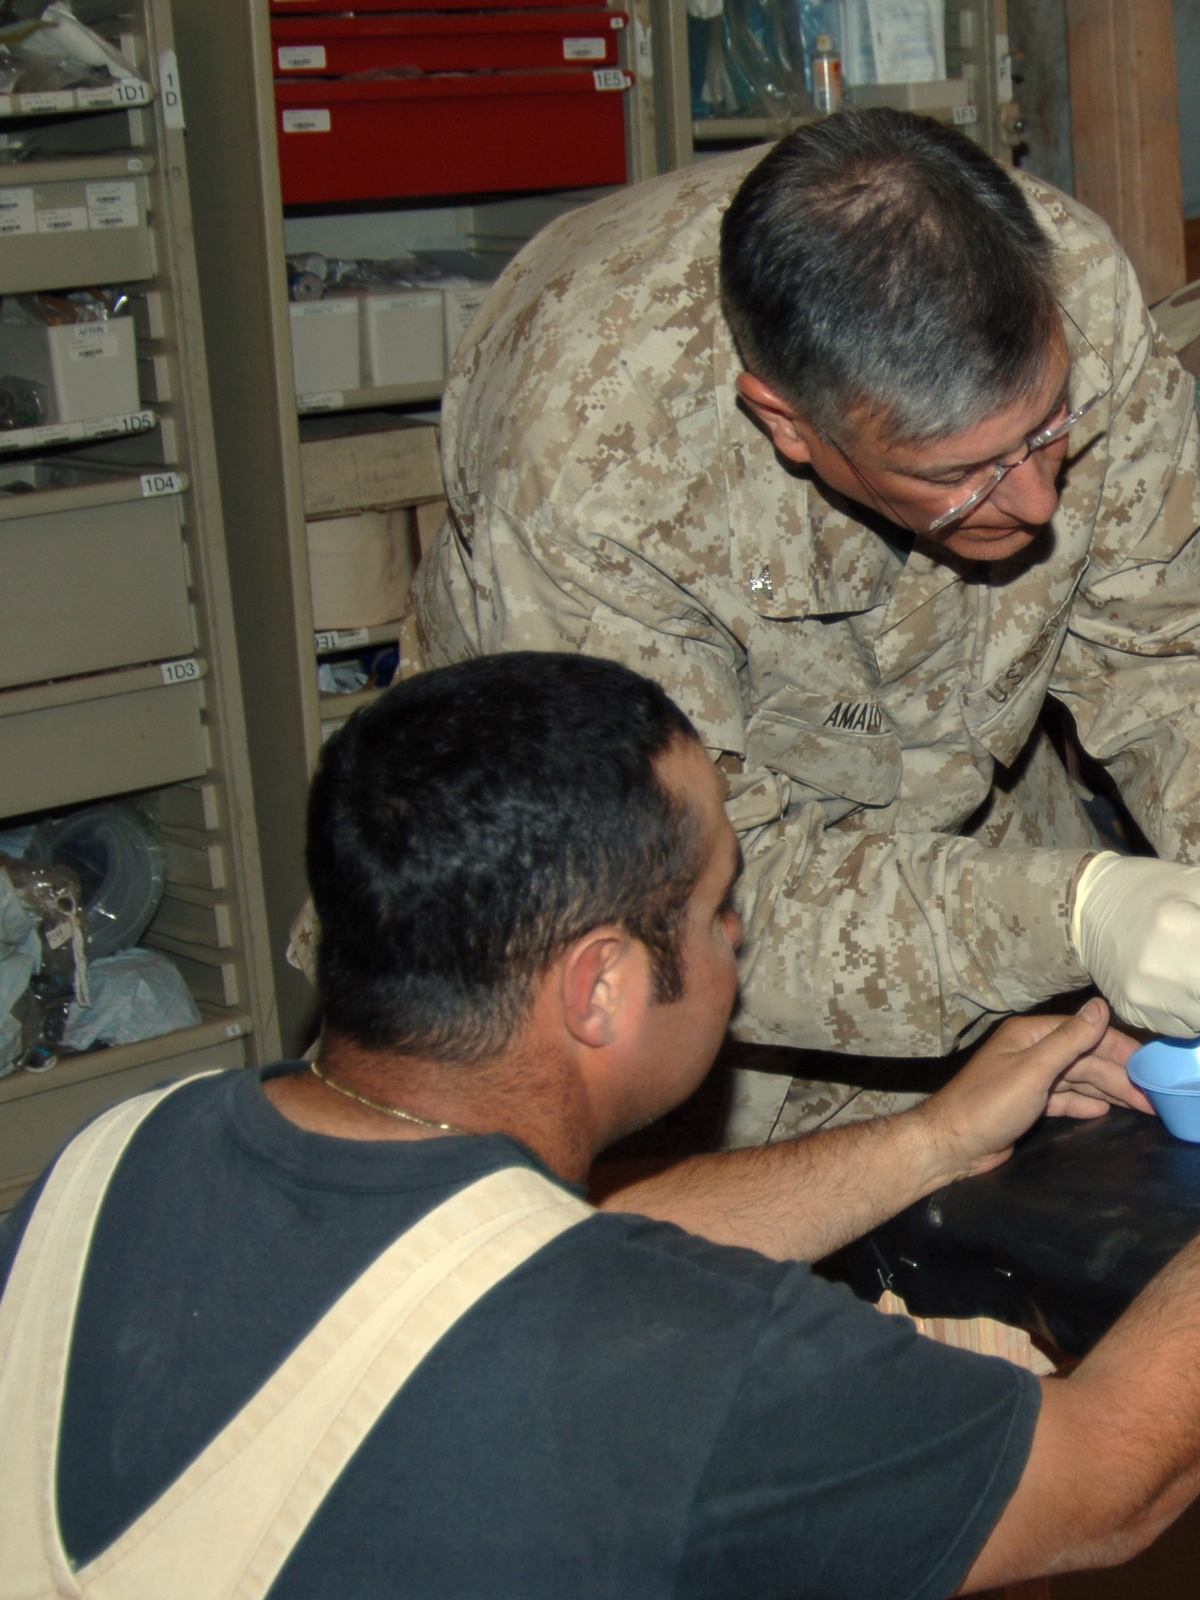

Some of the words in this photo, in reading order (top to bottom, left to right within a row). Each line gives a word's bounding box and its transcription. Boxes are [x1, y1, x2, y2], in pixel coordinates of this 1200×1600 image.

[596, 71, 622, 87] 1E5
[115, 85, 146, 101] 1D1
[122, 413, 152, 432] 1D5
[145, 475, 175, 493] 1D4
[165, 661, 196, 681] 1D3
